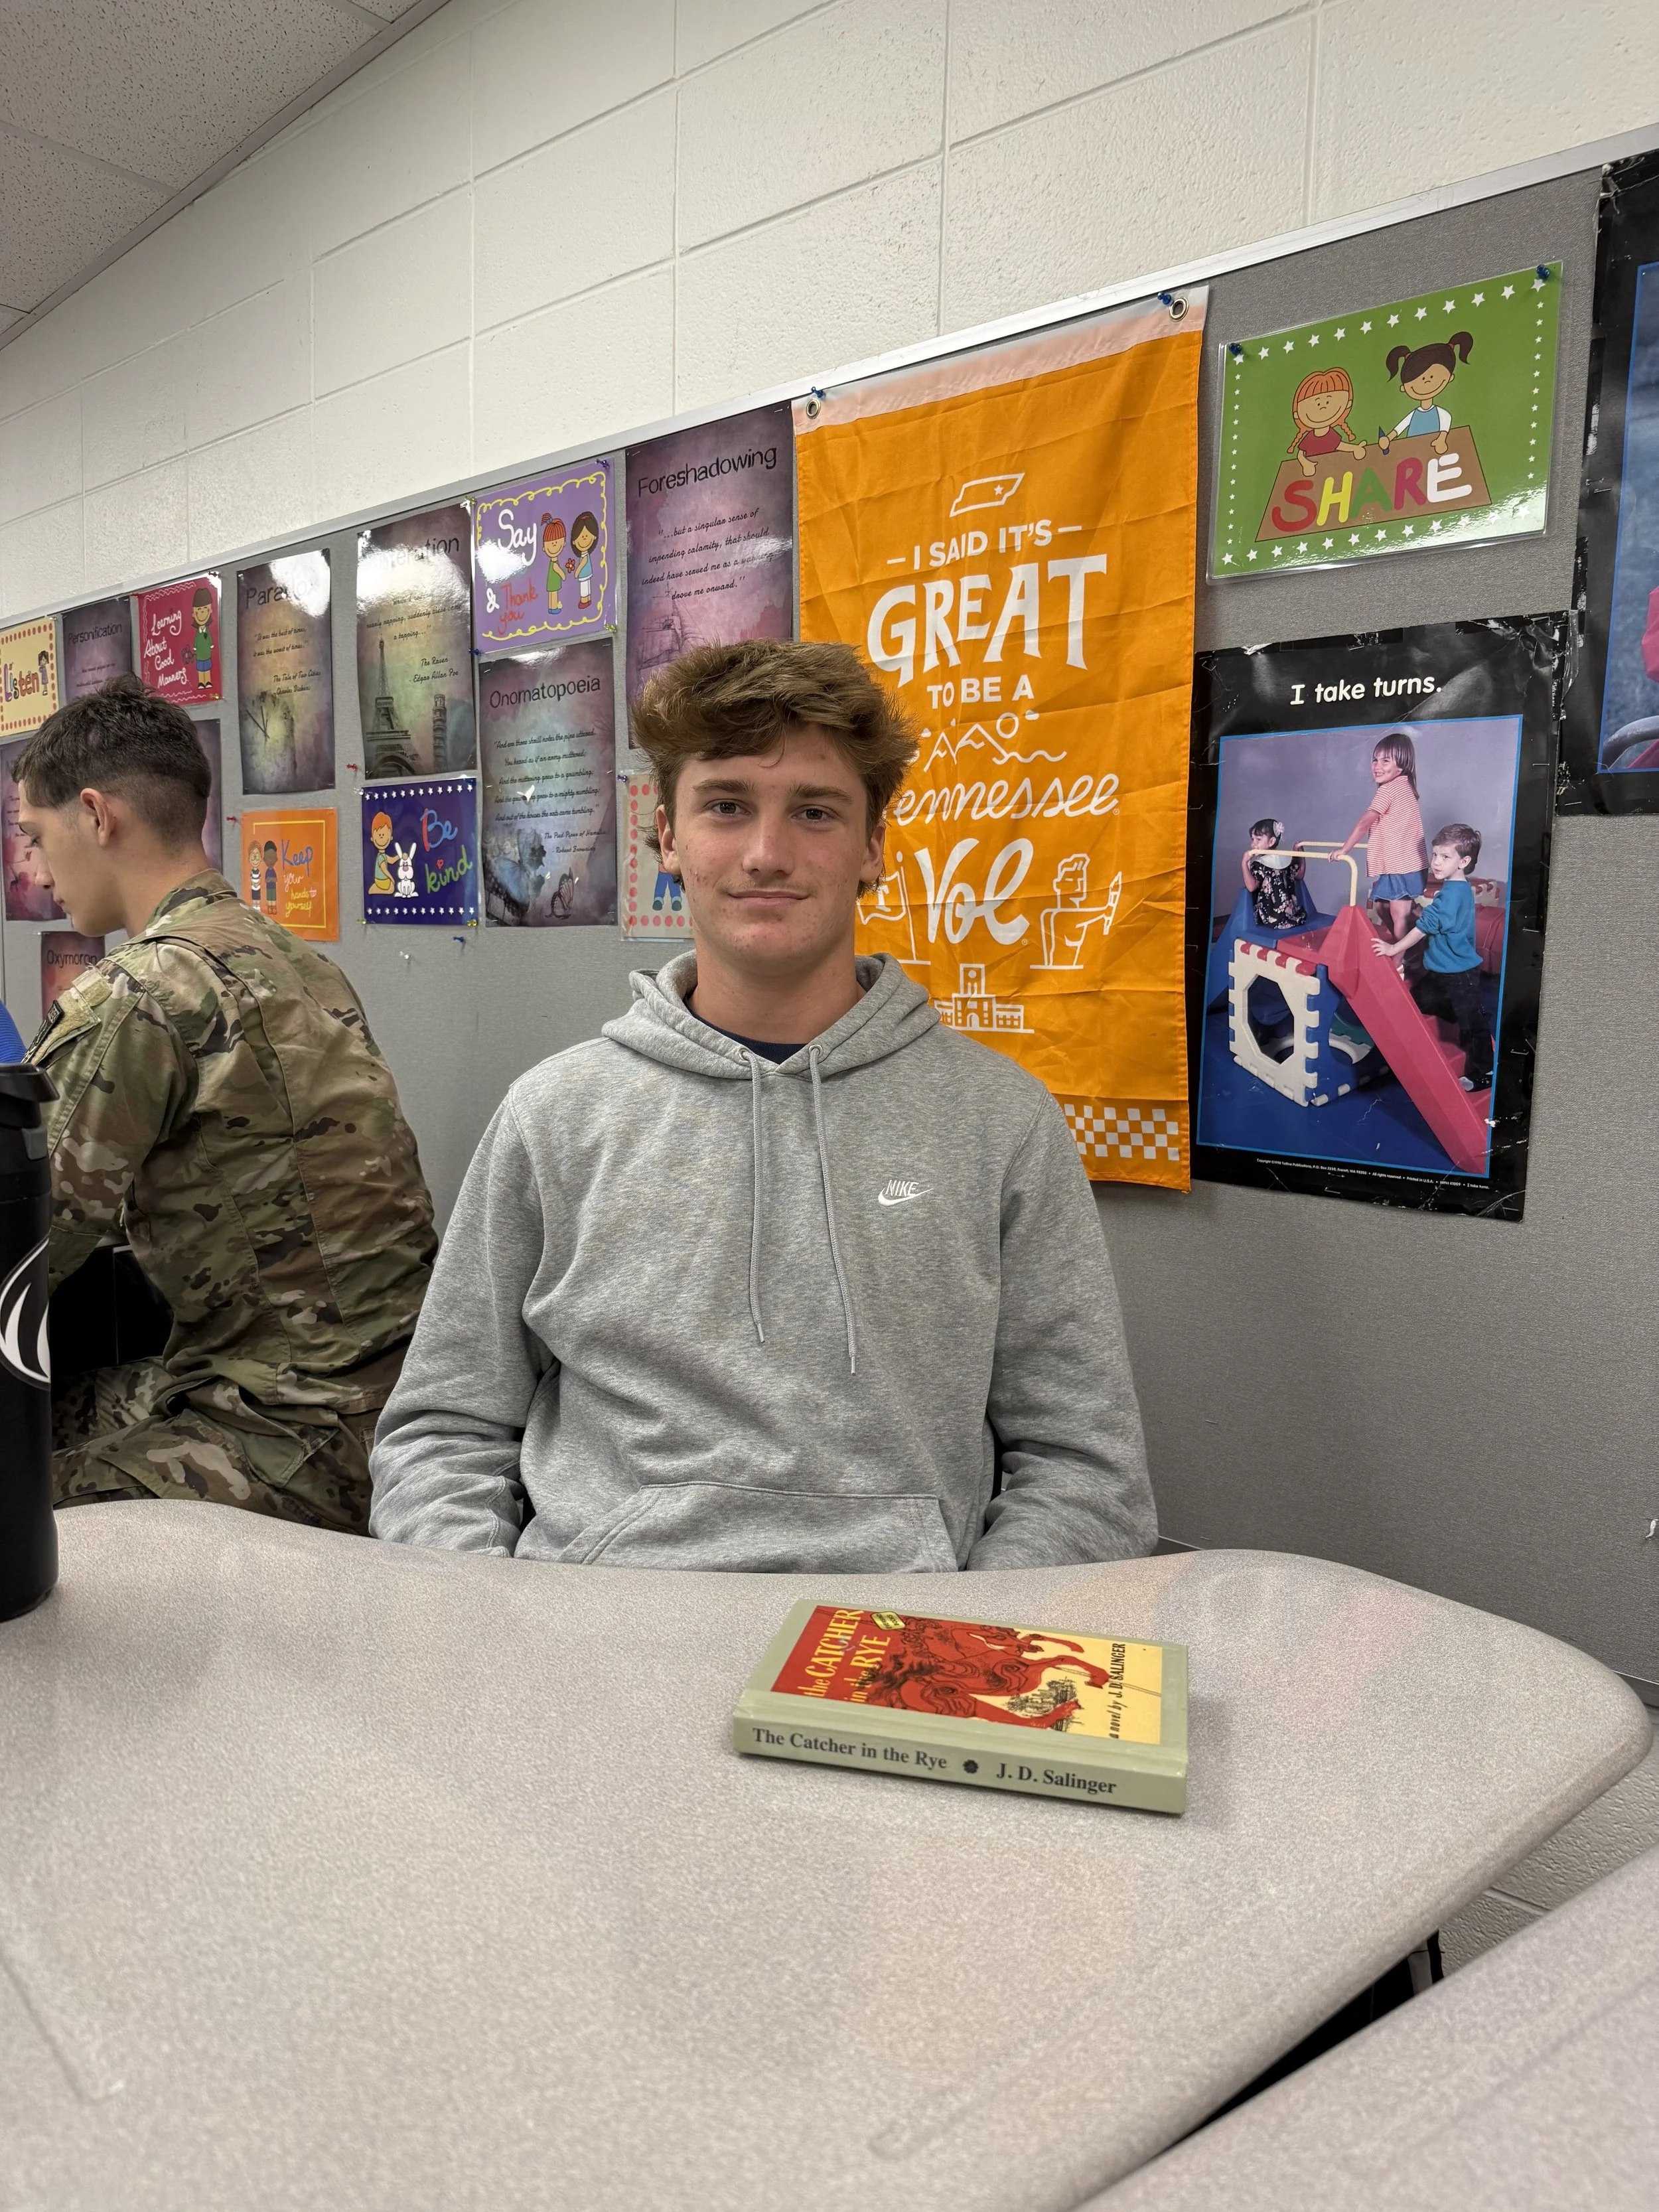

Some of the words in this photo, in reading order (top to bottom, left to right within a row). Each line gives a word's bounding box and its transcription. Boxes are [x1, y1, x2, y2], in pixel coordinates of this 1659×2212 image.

[638, 446, 777, 498] Foreshadowing
[1271, 453, 1472, 531] SHARE
[695, 517, 726, 532] singular
[728, 513, 748, 523] sense
[750, 508, 759, 520] of
[498, 509, 537, 565] Say
[649, 549, 685, 564] impending
[687, 540, 722, 555] calamity,
[725, 535, 741, 546] that
[743, 528, 770, 542] should
[914, 546, 920, 569] I
[929, 531, 988, 567] SAID
[999, 519, 1052, 553] IT'S
[642, 573, 664, 585] indeed
[666, 571, 683, 581] have
[685, 563, 709, 577] served
[486, 588, 499, 613] &
[500, 579, 538, 611] Thank
[672, 591, 691, 600] drove
[151, 611, 181, 636] Learning
[407, 609, 431, 620] suddenly
[432, 607, 446, 615] there
[498, 610, 524, 635] you
[867, 553, 1107, 689] GREAT
[68, 624, 122, 644] Personification
[144, 636, 167, 658] About
[155, 648, 175, 670] Good
[432, 656, 449, 665] Raven
[4, 662, 40, 702] Listen
[158, 668, 187, 689] Manners
[413, 674, 430, 684] Edgar
[431, 670, 448, 680] Allan
[449, 668, 459, 676] Poe
[490, 676, 600, 708] Onomatopoeia
[926, 682, 954, 709] TO
[960, 676, 1001, 703] BE
[1012, 674, 1035, 701] A
[1290, 684, 1305, 705] I
[1315, 679, 1366, 703] take
[1374, 676, 1441, 698] turns.
[892, 773, 1119, 826] ennessee
[420, 808, 458, 851] Be
[579, 830, 585, 838] of
[281, 839, 313, 877] Keep
[425, 844, 472, 893] kind
[283, 873, 304, 892] your
[291, 887, 309, 899] hands
[914, 838, 1034, 945] Vol
[285, 901, 313, 918] yourself
[46, 950, 97, 968] Oxymoron
[885, 1179, 919, 1197] NIKE
[805, 1609, 865, 1677] CATCHER
[849, 1635, 891, 1669] RYE
[1110, 1643, 1125, 1680] SALINGER
[798, 1678, 830, 1697] the
[844, 1691, 868, 1702] in
[1107, 1700, 1128, 1710] by
[1107, 1710, 1121, 1732] novel
[753, 1728, 784, 1745] The
[790, 1732, 856, 1755] Catcher
[861, 1743, 877, 1759] in
[883, 1747, 909, 1763] the
[914, 1750, 947, 1770] Rye
[996, 1763, 1012, 1779] J.
[1019, 1765, 1038, 1782] D.
[1043, 1769, 1117, 1795] Salinger
